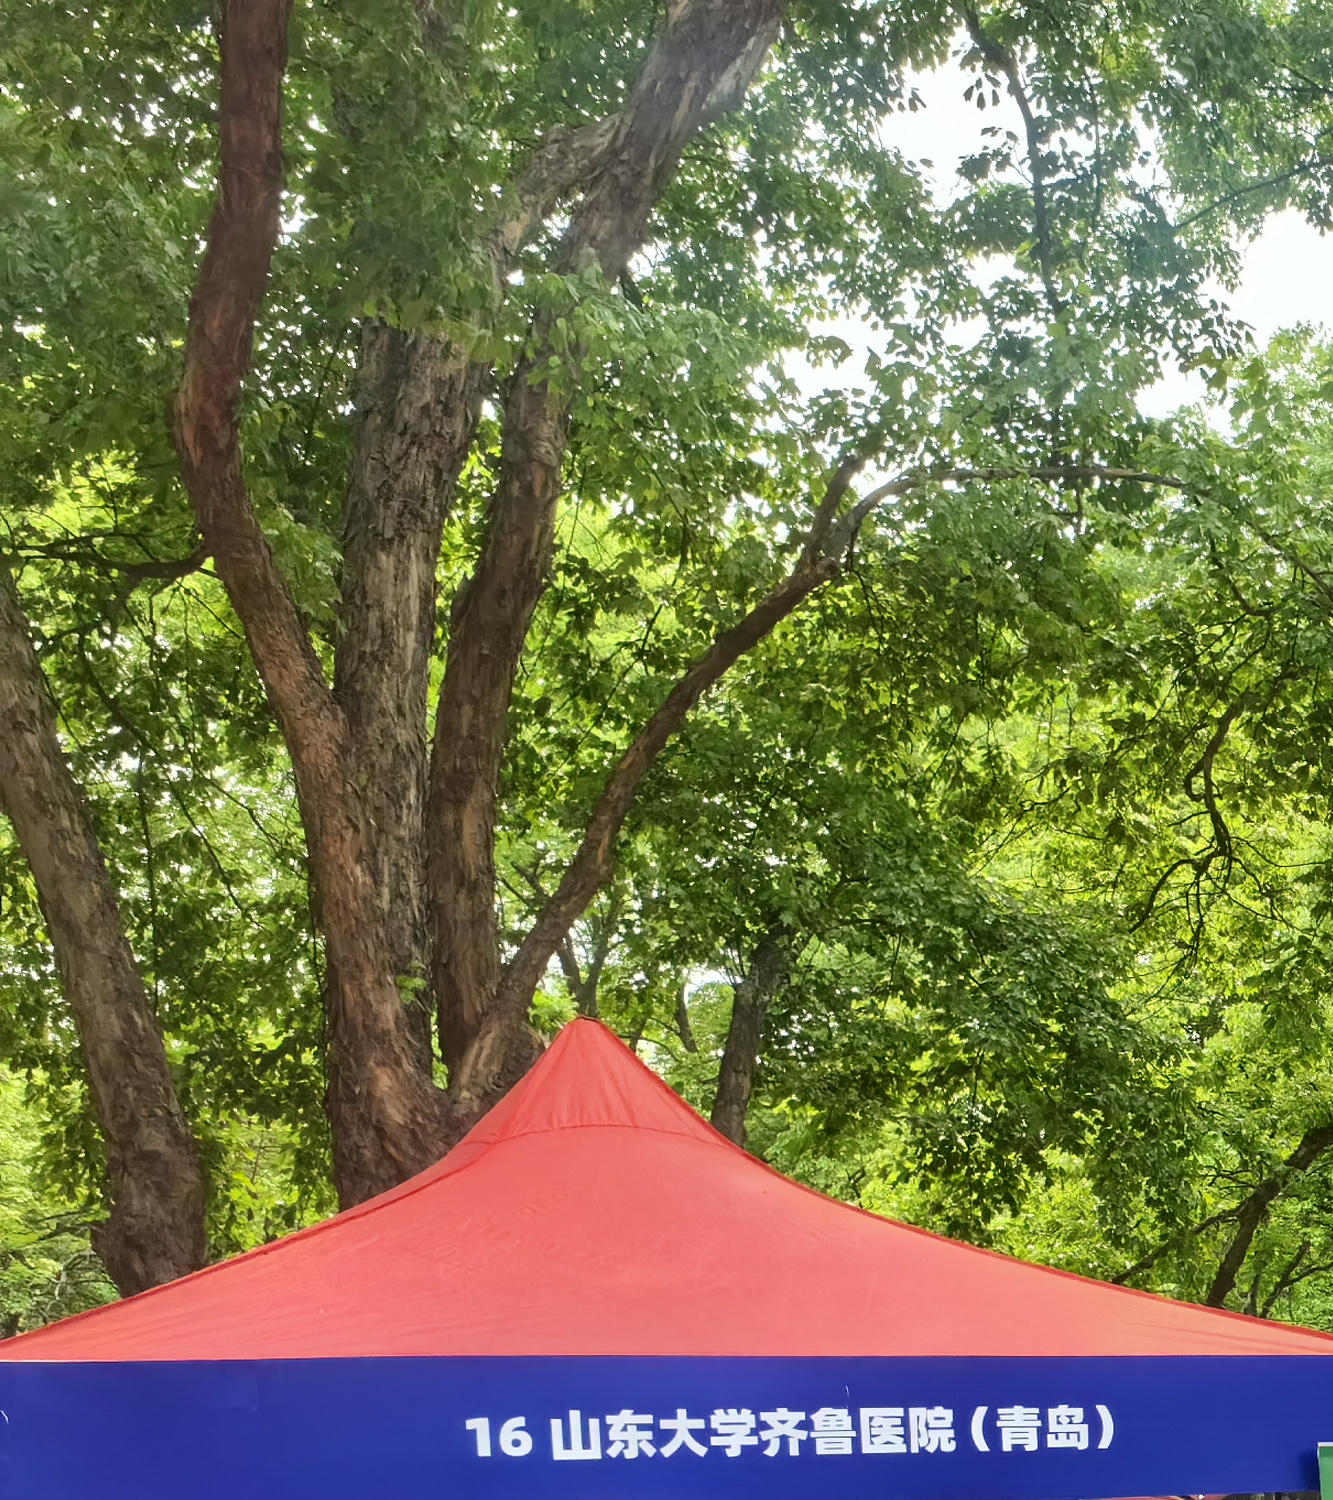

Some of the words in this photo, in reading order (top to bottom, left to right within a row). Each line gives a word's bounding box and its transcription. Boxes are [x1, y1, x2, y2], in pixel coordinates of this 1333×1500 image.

[466, 1416, 532, 1458] 16
[551, 1403, 1115, 1461] 山东大学齐鲁医院（青岛）
